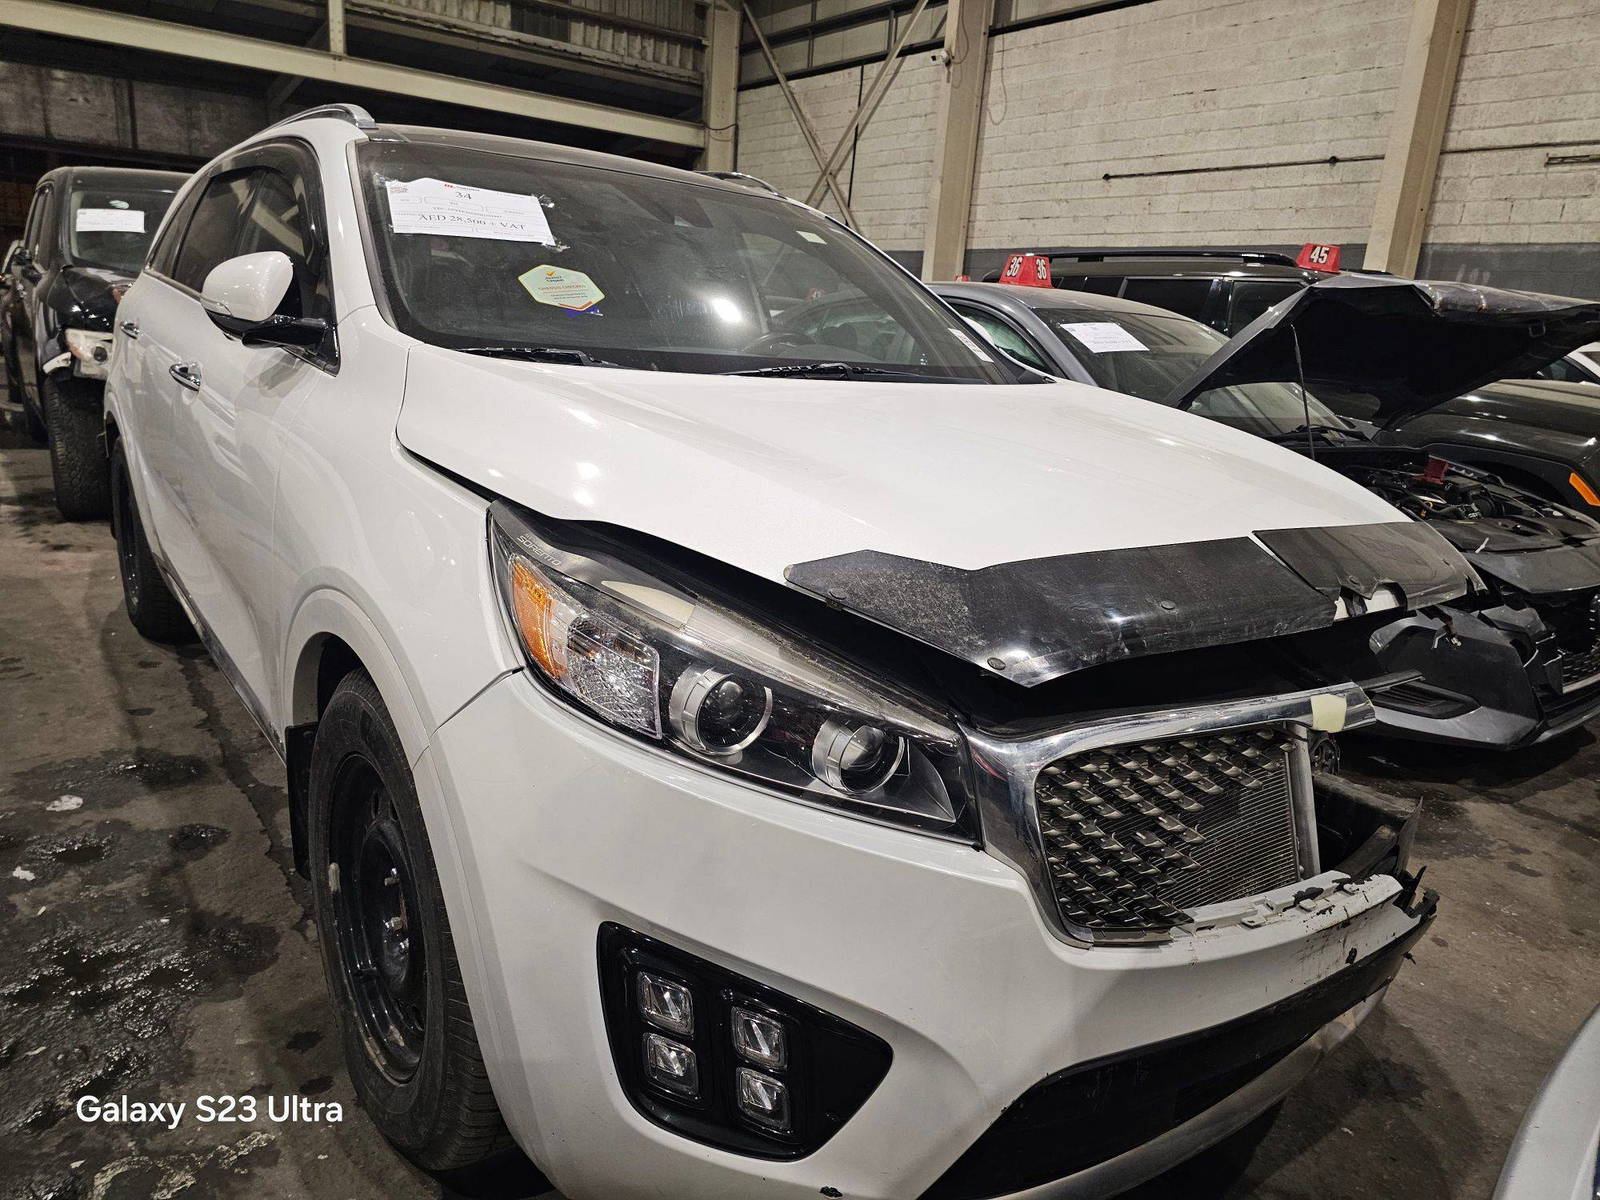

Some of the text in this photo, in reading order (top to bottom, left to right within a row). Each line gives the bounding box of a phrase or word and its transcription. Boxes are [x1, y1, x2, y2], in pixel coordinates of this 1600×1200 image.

[455, 191, 472, 200] 34
[418, 214, 446, 223] AED
[499, 222, 526, 231] VAT
[1310, 246, 1330, 264] 45
[1006, 256, 1023, 277] 36
[1035, 258, 1047, 280] 36
[517, 535, 561, 566] SORENTO
